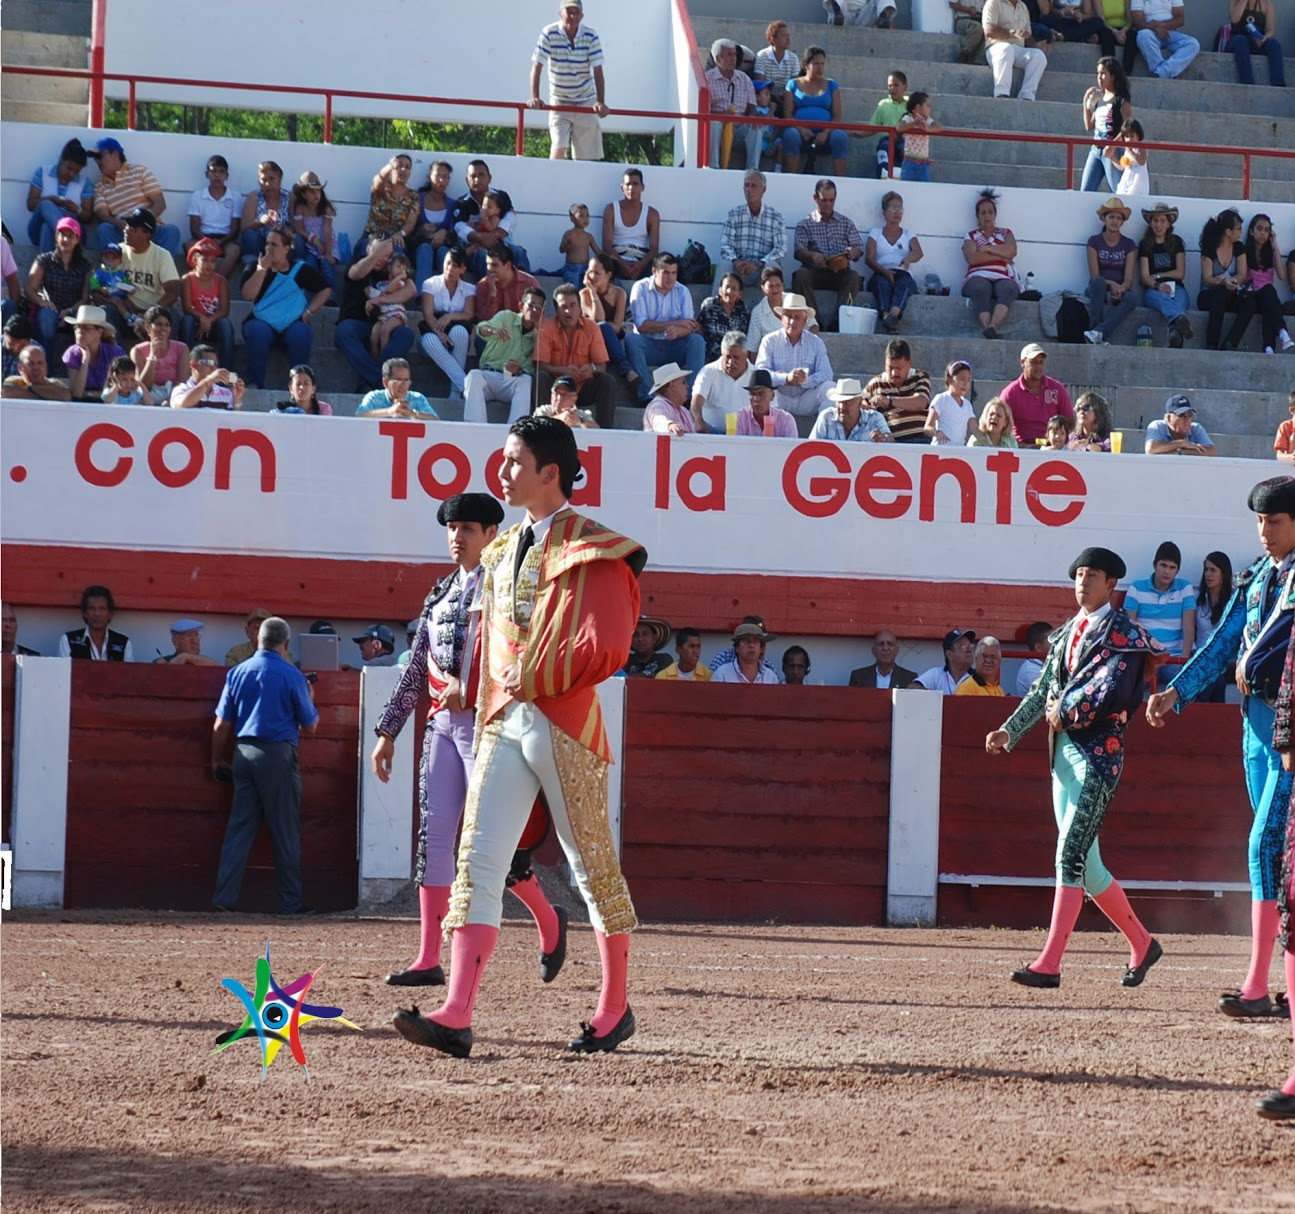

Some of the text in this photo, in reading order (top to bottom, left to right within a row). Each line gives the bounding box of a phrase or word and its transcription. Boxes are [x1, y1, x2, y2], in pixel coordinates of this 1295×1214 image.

[76, 423, 276, 493] con
[655, 435, 726, 512] la
[782, 441, 1087, 527] Gente
